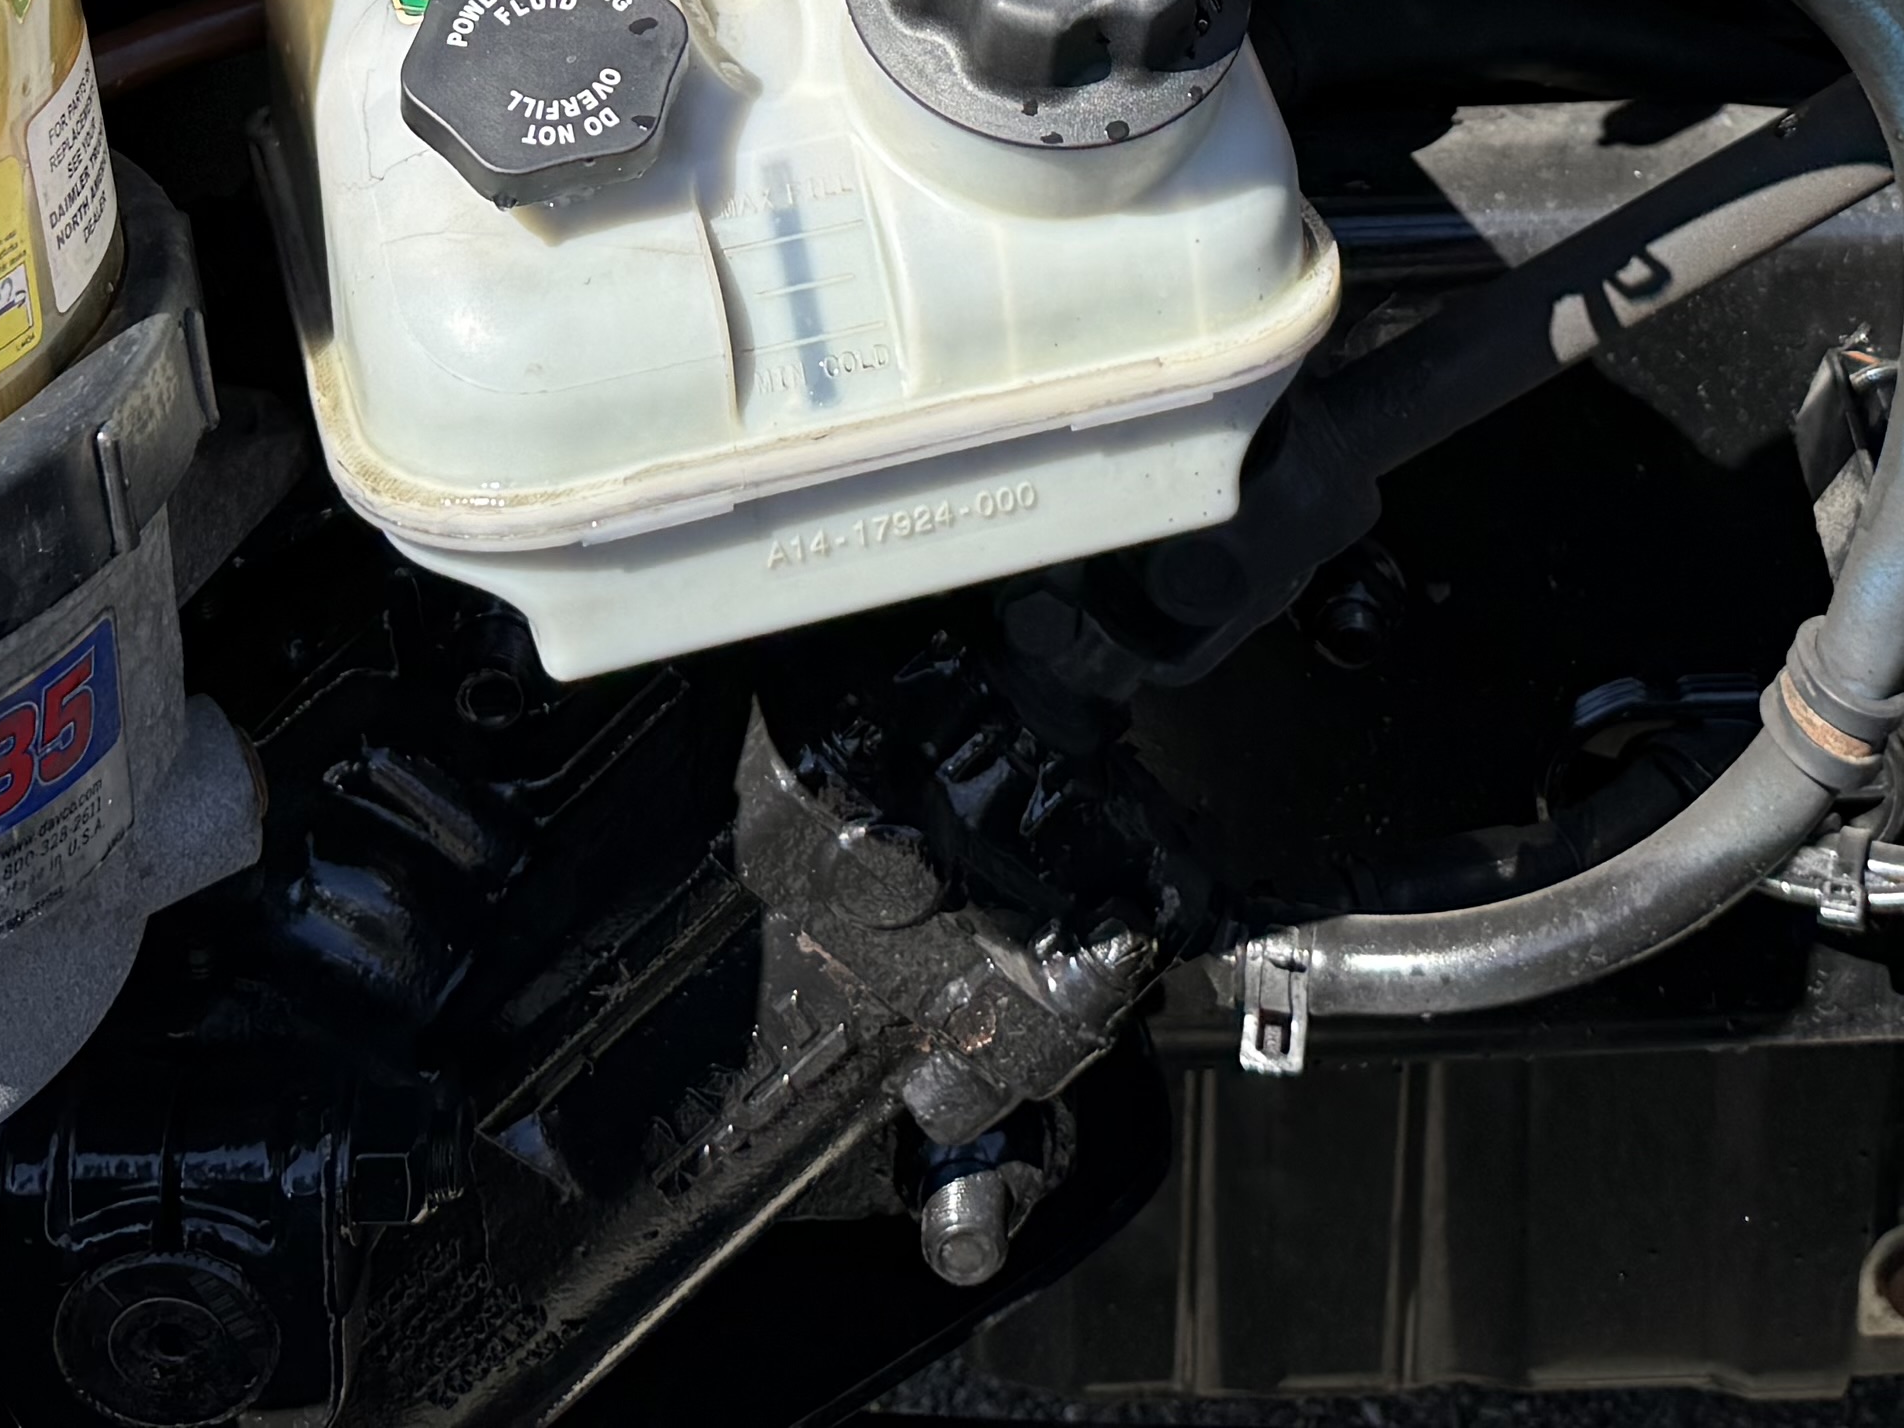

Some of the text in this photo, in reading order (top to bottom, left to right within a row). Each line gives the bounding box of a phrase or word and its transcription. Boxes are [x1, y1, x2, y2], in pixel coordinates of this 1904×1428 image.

[507, 67, 622, 121] OVERFILL
[521, 106, 620, 145] DO NOT
[49, 167, 90, 229] DAIMLER
[719, 173, 855, 219] MAX FILL
[56, 198, 91, 250] NORTH
[754, 344, 890, 395] MIN COLD
[766, 479, 1039, 570] A14-17924-000
[3, 796, 102, 881] 800-328-2611
[68, 822, 105, 857] U.S.A.
